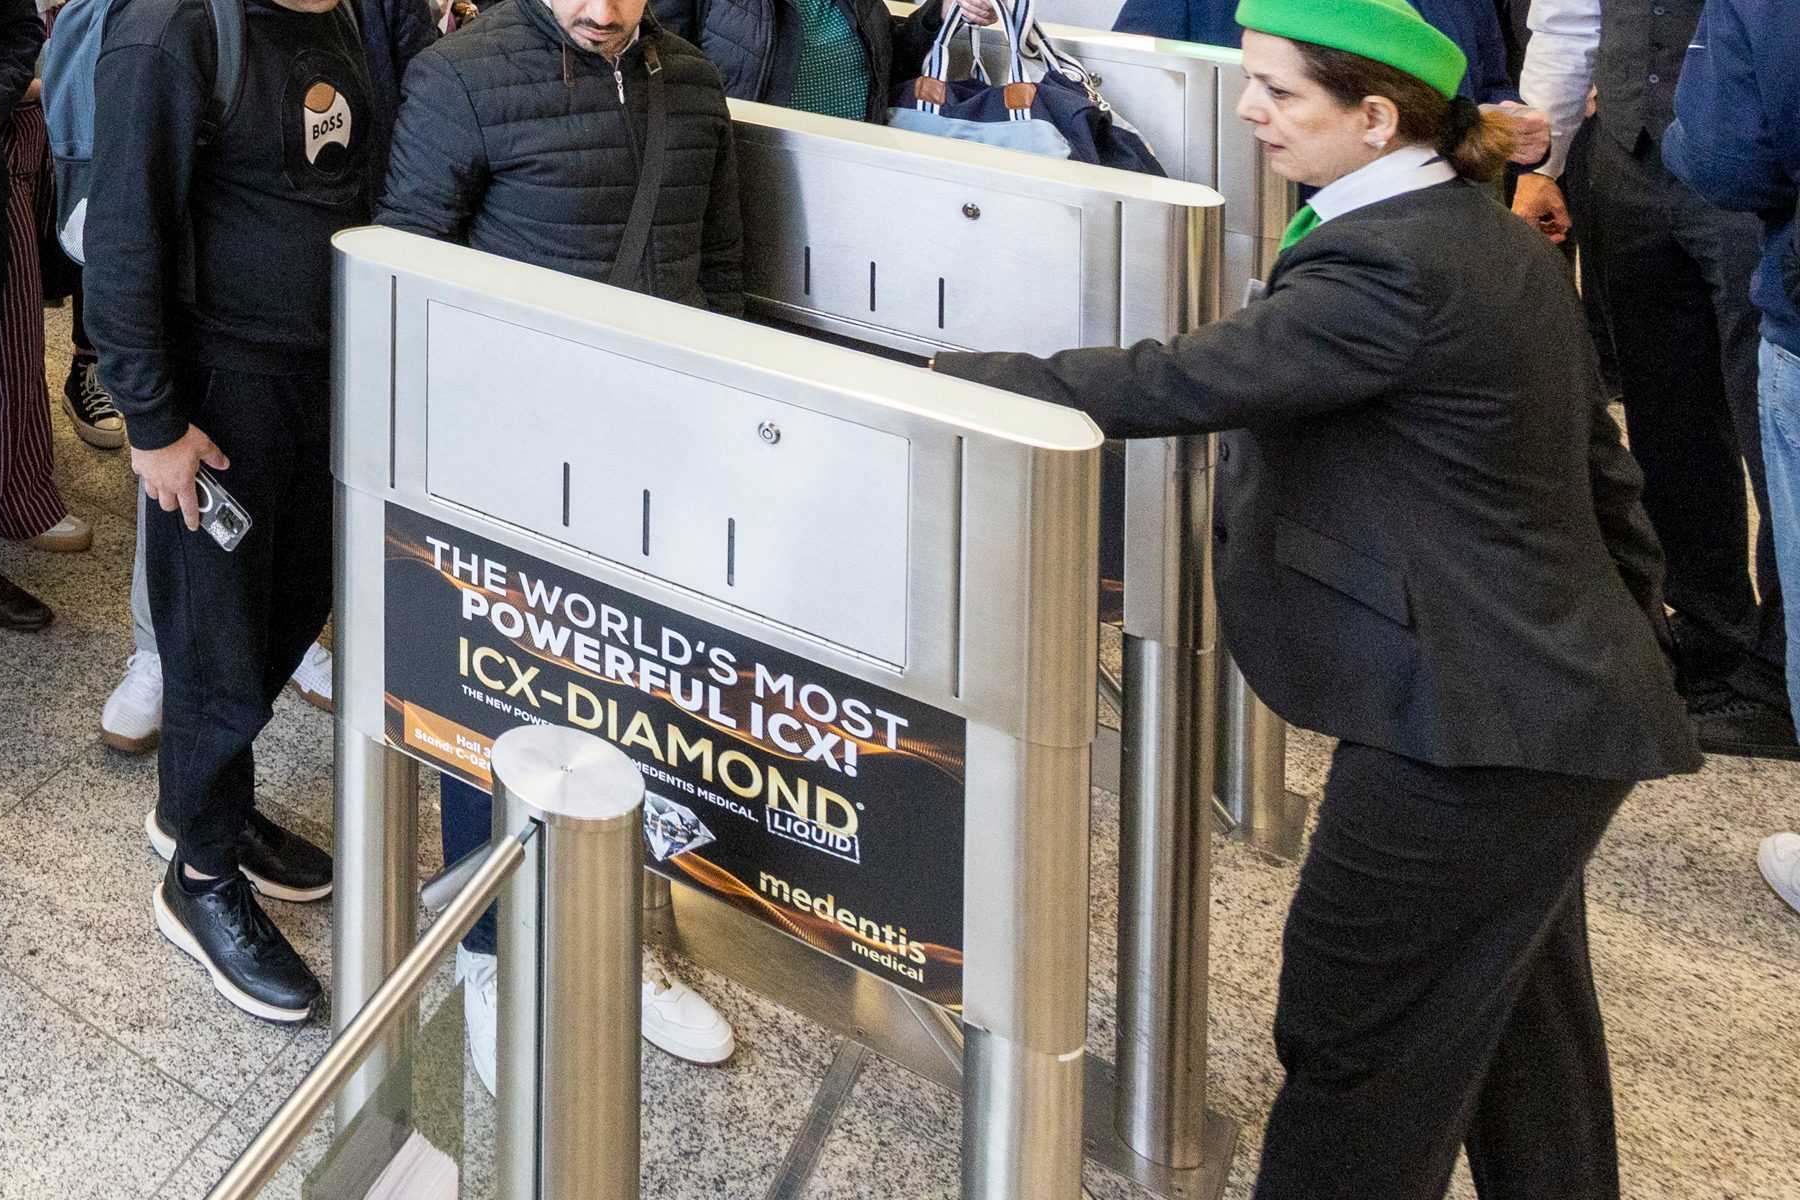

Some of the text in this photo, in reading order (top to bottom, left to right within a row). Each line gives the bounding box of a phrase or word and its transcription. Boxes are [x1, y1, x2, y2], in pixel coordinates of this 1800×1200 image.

[312, 112, 344, 140] BOSS
[425, 536, 909, 752] THE WORLD'S MOST
[460, 587, 860, 778] POWERFUL ICX!
[414, 727, 453, 755] Stand:
[456, 733, 481, 753] Hall
[457, 636, 860, 838] ICX-DIAMOND
[462, 684, 484, 702] THE
[485, 694, 513, 713] NEW
[514, 708, 555, 727] POWE
[632, 757, 695, 796] MEDENTIS
[773, 812, 852, 853] LIQUID
[760, 870, 927, 965] medentis
[852, 940, 924, 983] medical
